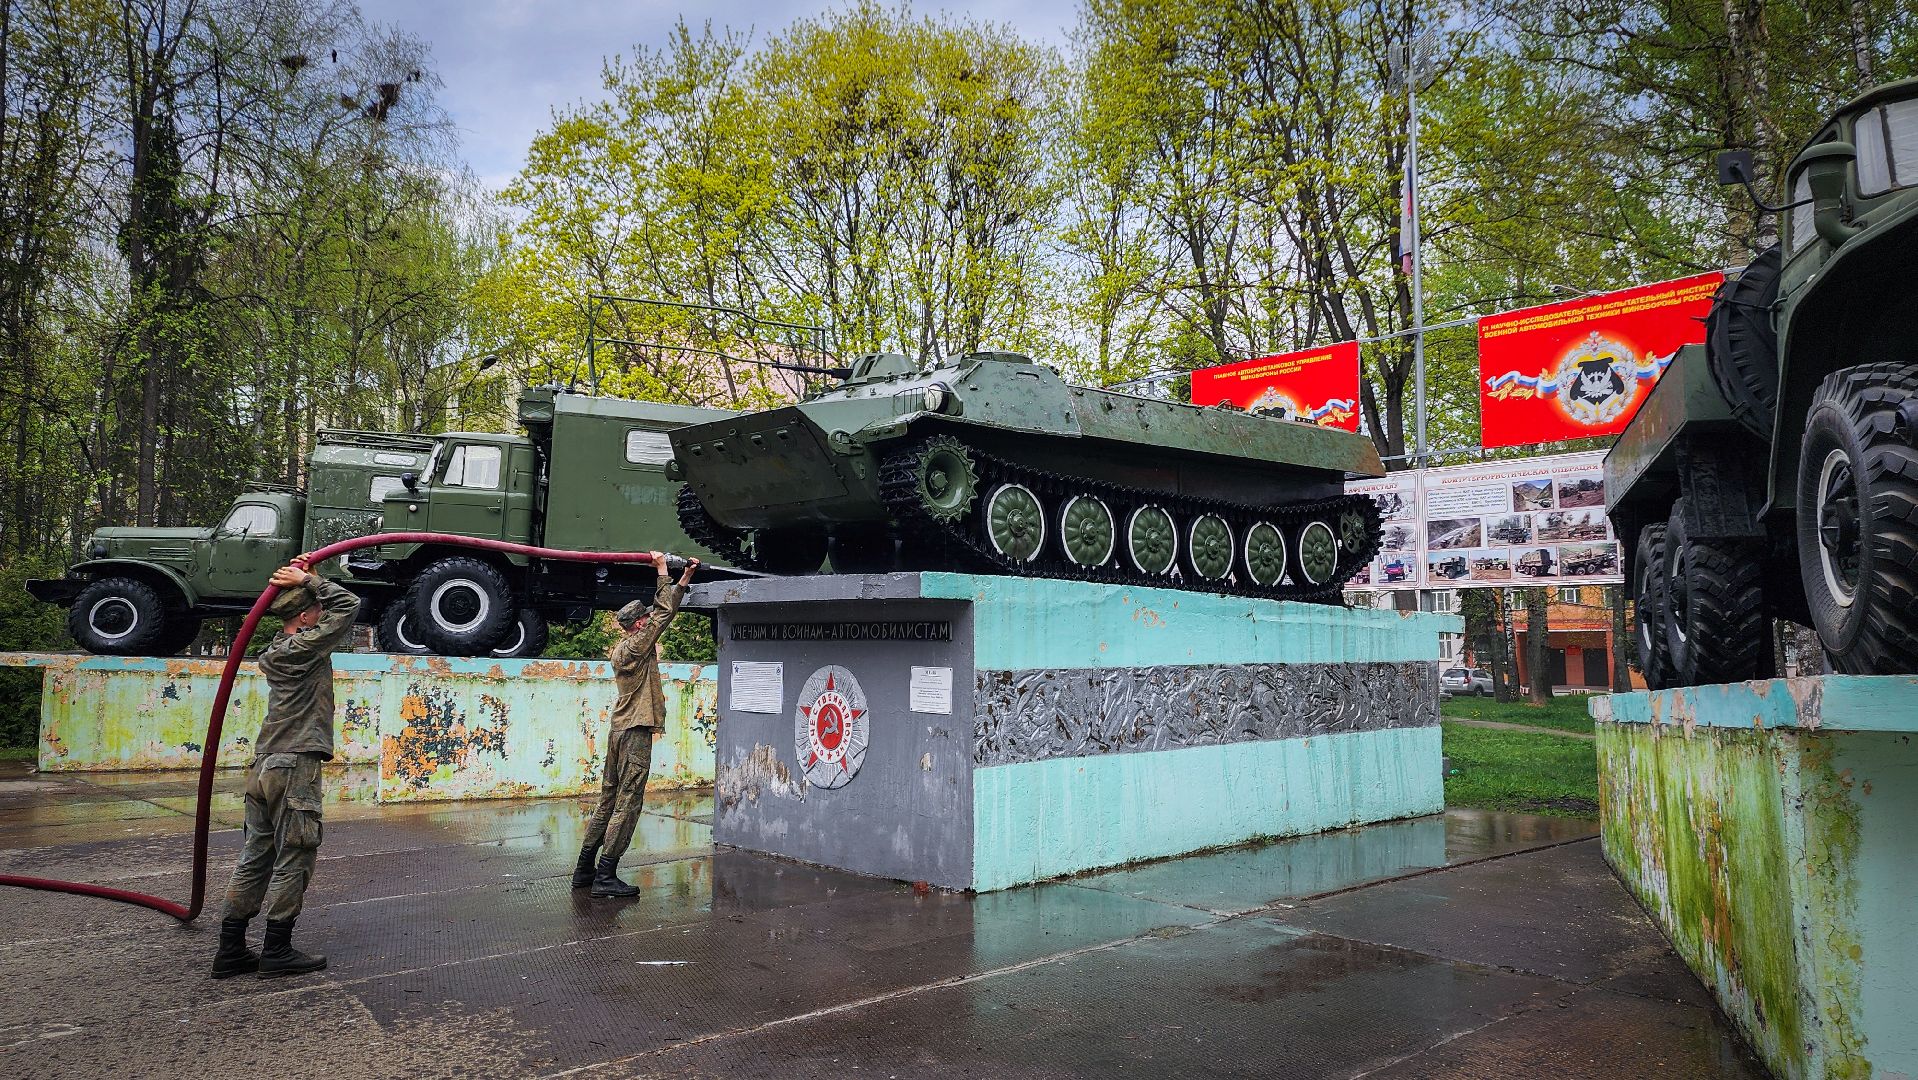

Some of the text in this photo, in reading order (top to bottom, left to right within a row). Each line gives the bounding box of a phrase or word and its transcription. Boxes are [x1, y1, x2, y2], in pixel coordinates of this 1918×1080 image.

[1490, 304, 1602, 330] НАУЧНО-ИССЛЕДОВАТЕЛЬСКИЙ
[1603, 289, 1676, 310] ИСПЫТАТЕЛЬНЫЙ
[1677, 281, 1720, 296] ИНСТИТУТ
[1484, 327, 1518, 338] ВОЕННОЙ
[1519, 315, 1584, 332] АВТОМОБИЛЬНОЙ
[1586, 308, 1620, 321] ТЕХНИКИ
[1621, 298, 1682, 314] МИНОБОРОНЫ
[1296, 354, 1332, 366] УПРАВЛЕНИЕ
[1279, 366, 1302, 375] РОССИИ
[771, 624, 778, 639] И
